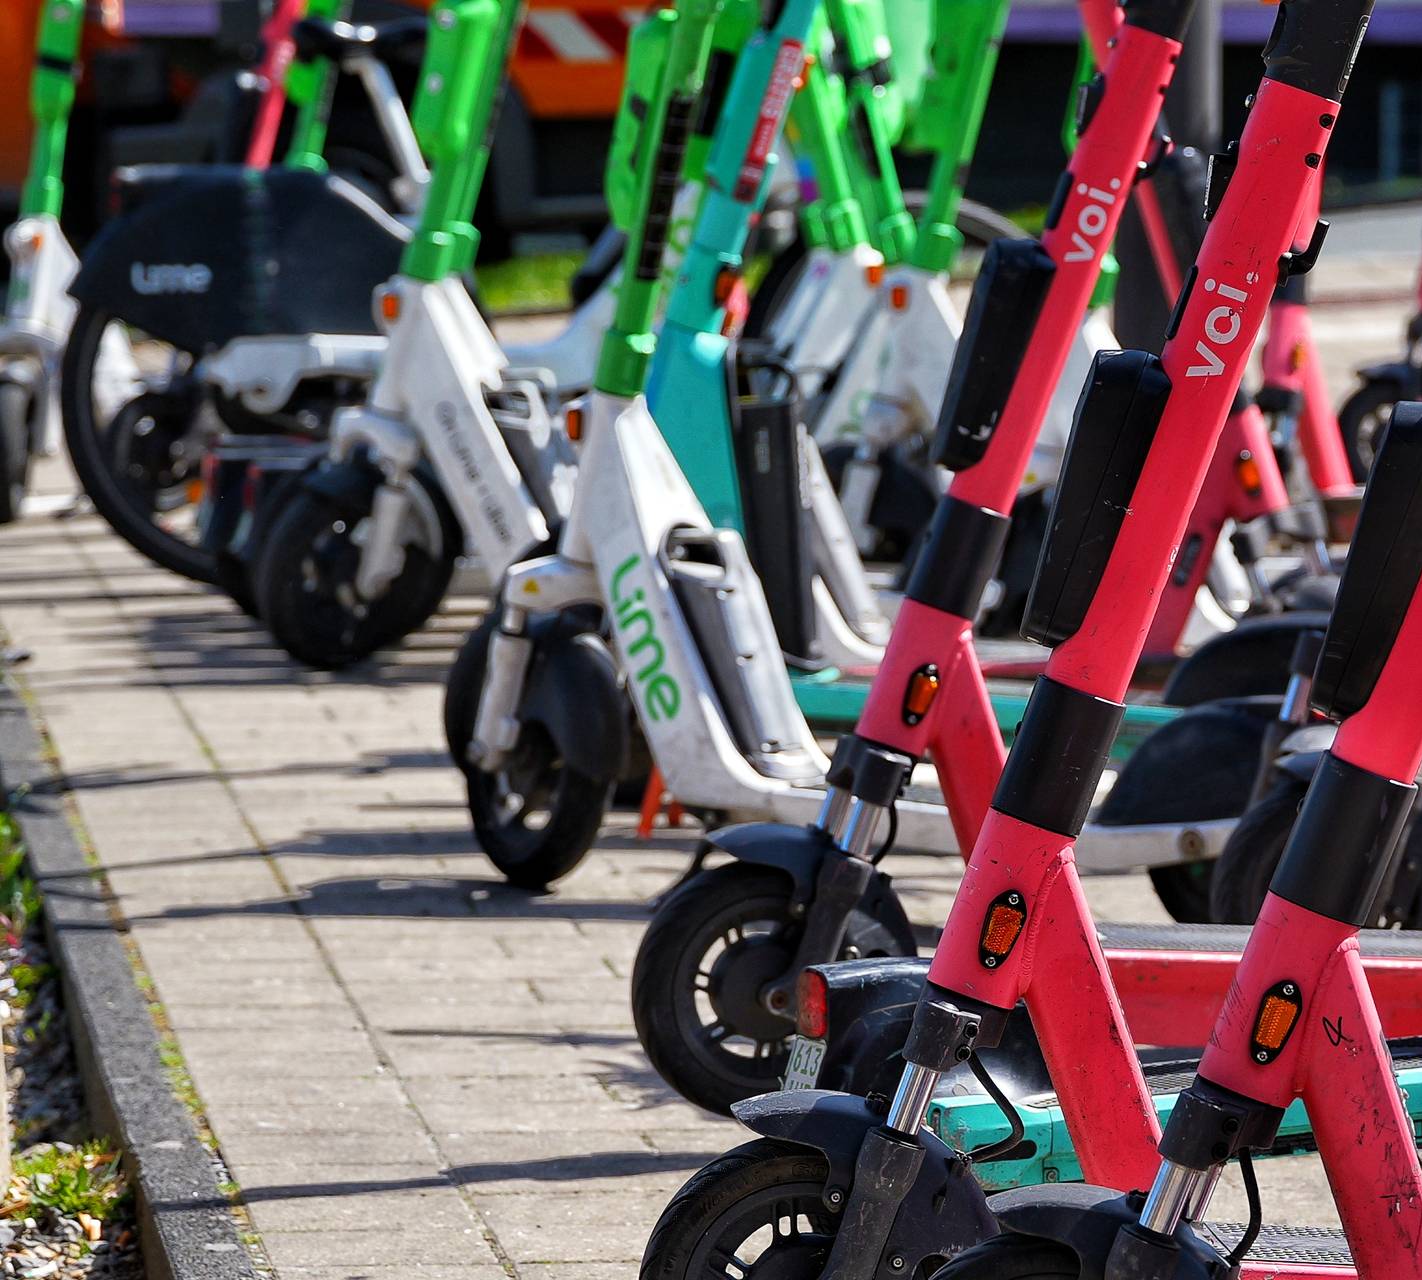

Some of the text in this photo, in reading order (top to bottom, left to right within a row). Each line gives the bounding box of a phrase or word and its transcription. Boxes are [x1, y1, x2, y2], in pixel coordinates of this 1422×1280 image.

[1064, 178, 1121, 262] voi.
[1185, 271, 1260, 377] voi.
[610, 553, 682, 723] Lime
[793, 1043, 823, 1077] 613
